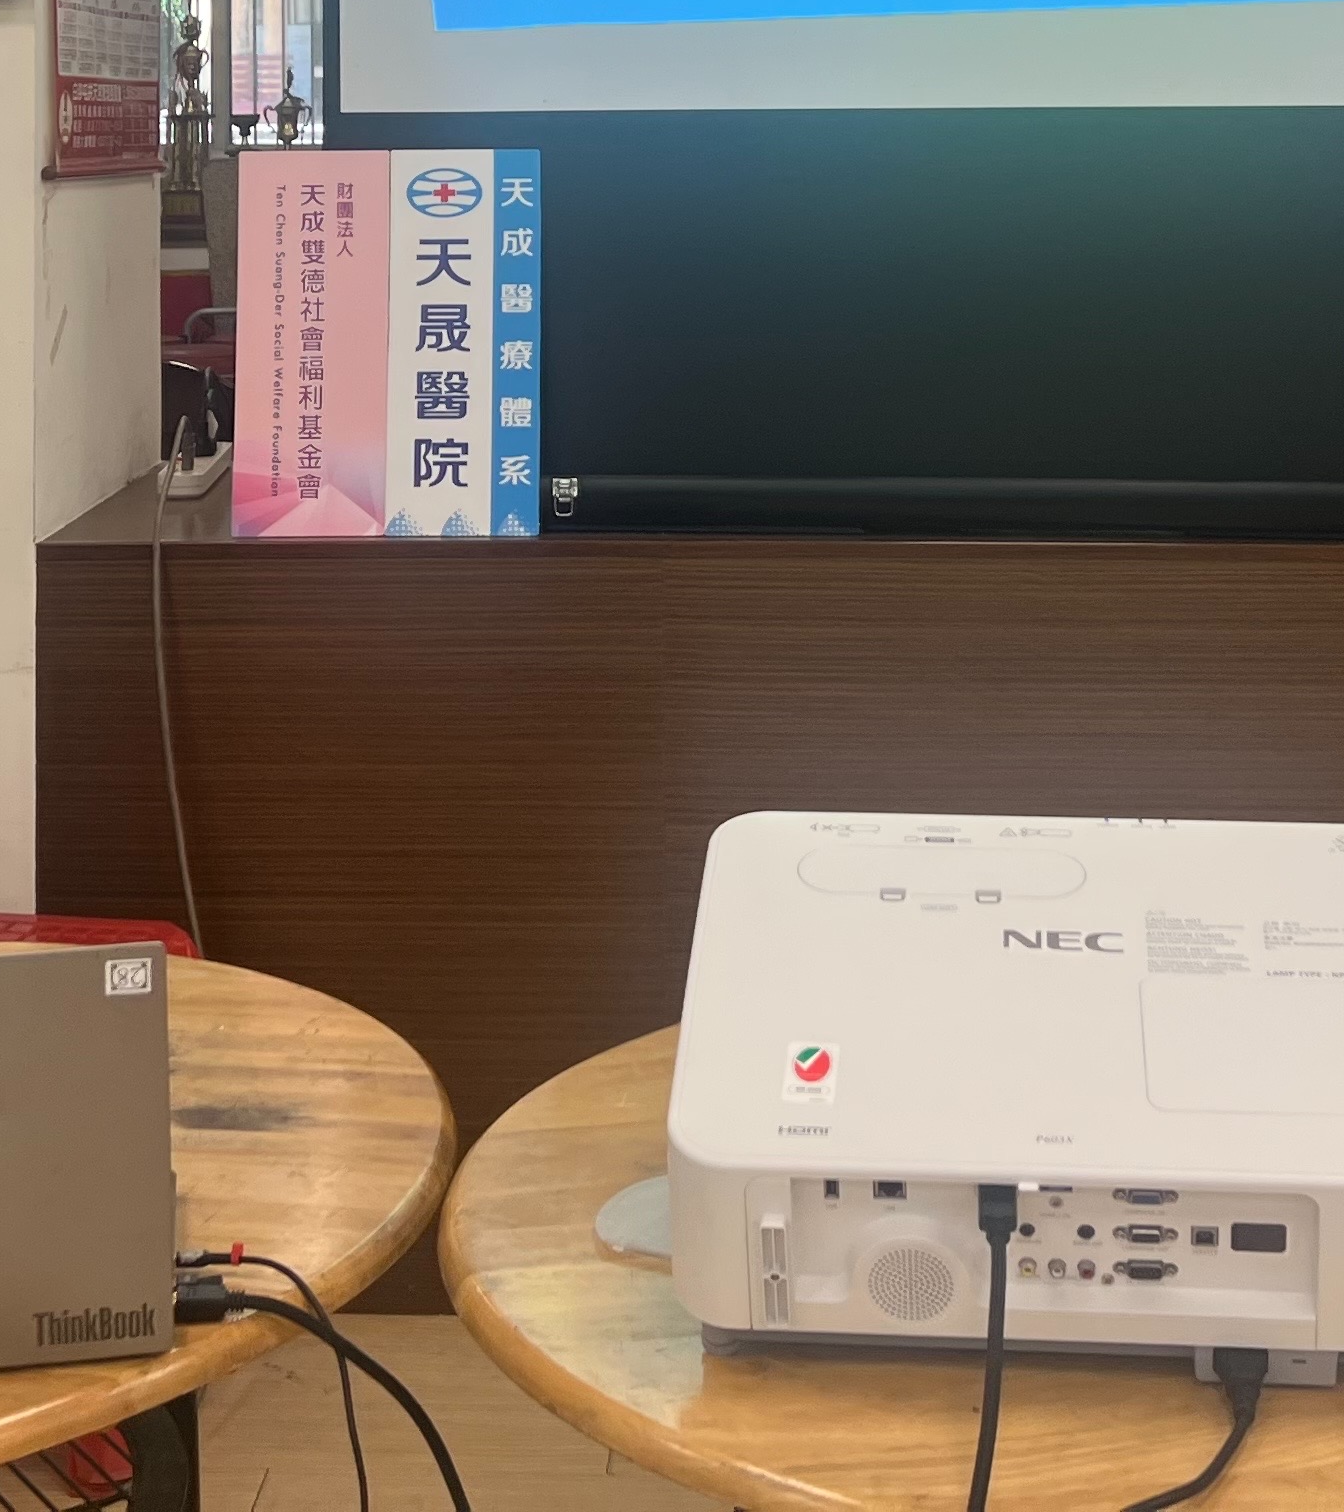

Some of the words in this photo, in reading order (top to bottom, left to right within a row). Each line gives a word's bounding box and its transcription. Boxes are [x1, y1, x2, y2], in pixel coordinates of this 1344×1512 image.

[276, 184, 287, 208] Ten
[336, 182, 355, 259] 財團法人
[273, 323, 285, 361] Social
[297, 183, 326, 500] 天成雙德社會福利基金會
[412, 237, 473, 488] 天晟醫院
[498, 176, 534, 487] 天成醫療體系
[272, 367, 284, 419] Welfare
[271, 425, 283, 497] Foundation
[1002, 929, 1124, 953] NEC
[32, 1301, 156, 1348] ThinkBook
